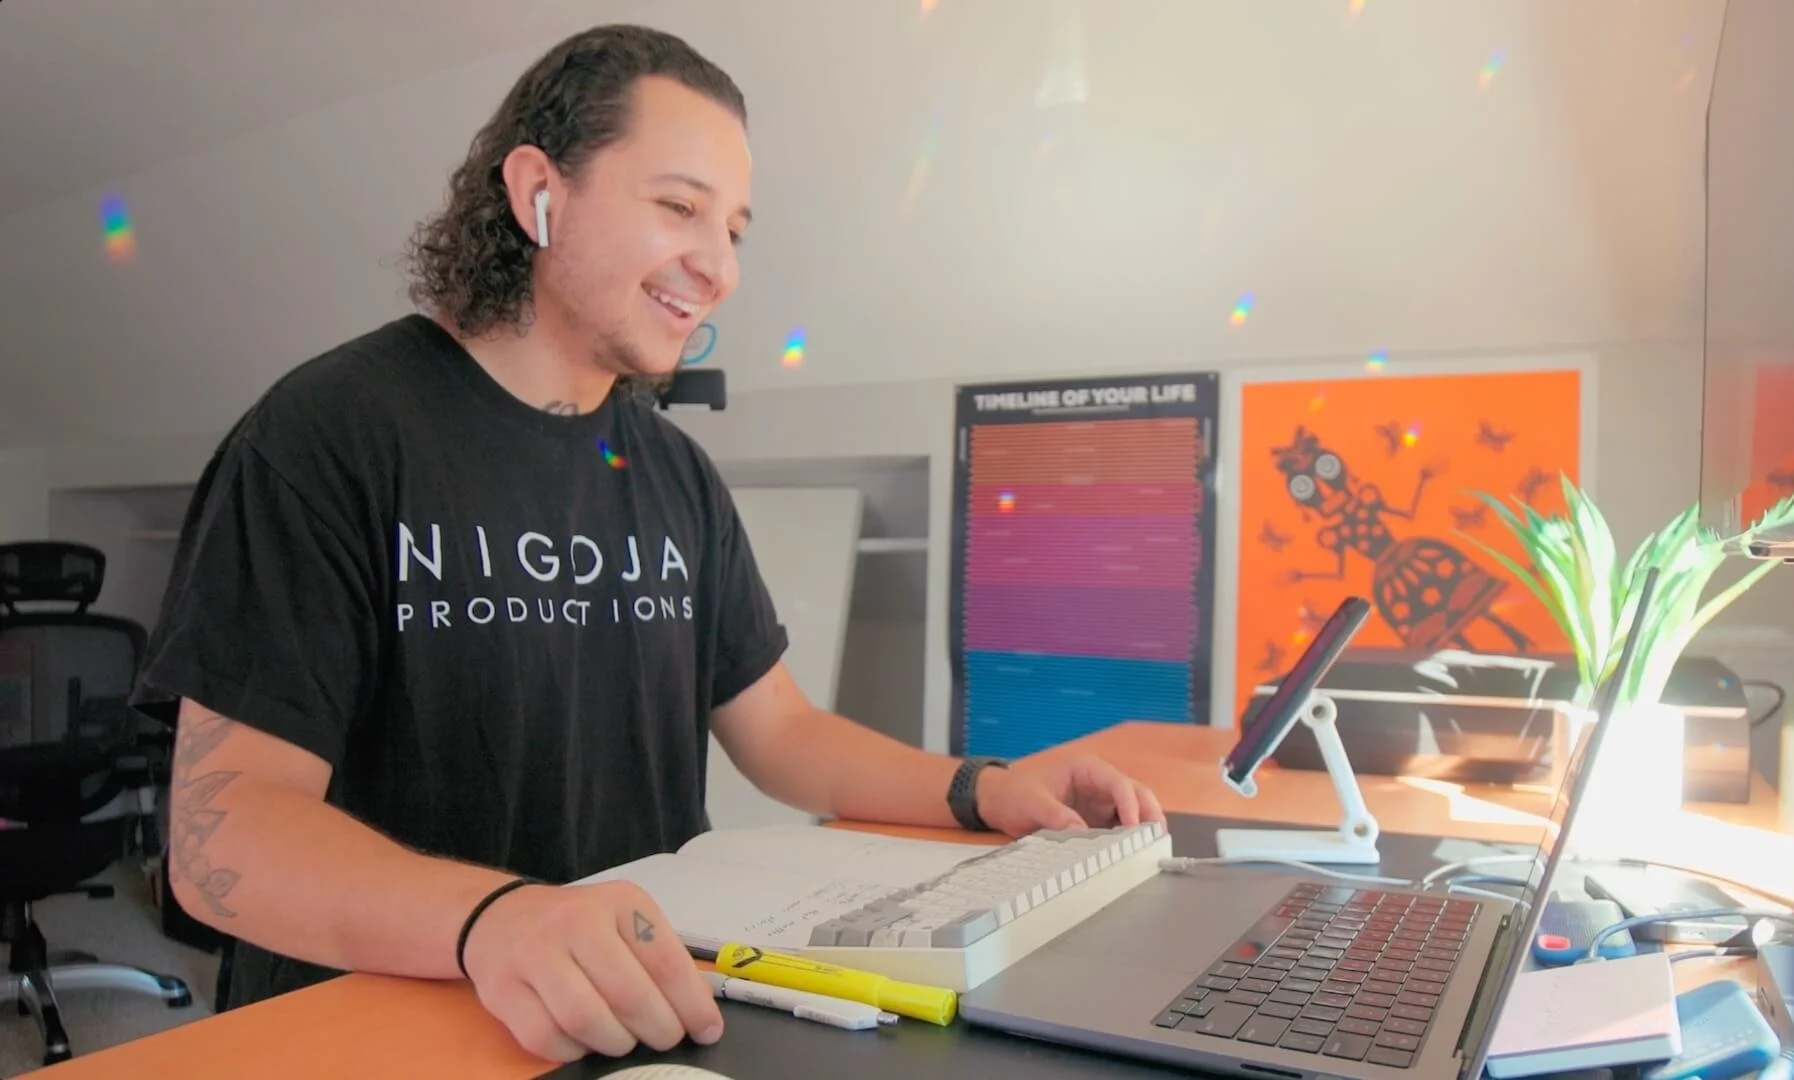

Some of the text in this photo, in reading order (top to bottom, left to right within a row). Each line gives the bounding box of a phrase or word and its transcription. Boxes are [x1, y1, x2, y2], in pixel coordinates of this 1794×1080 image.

[974, 391, 1060, 411] TIMELINE
[1062, 389, 1090, 407] OF
[1092, 386, 1147, 404] YOUR
[1151, 384, 1196, 402] LIFE
[397, 596, 693, 632] PRODUCTIONS
